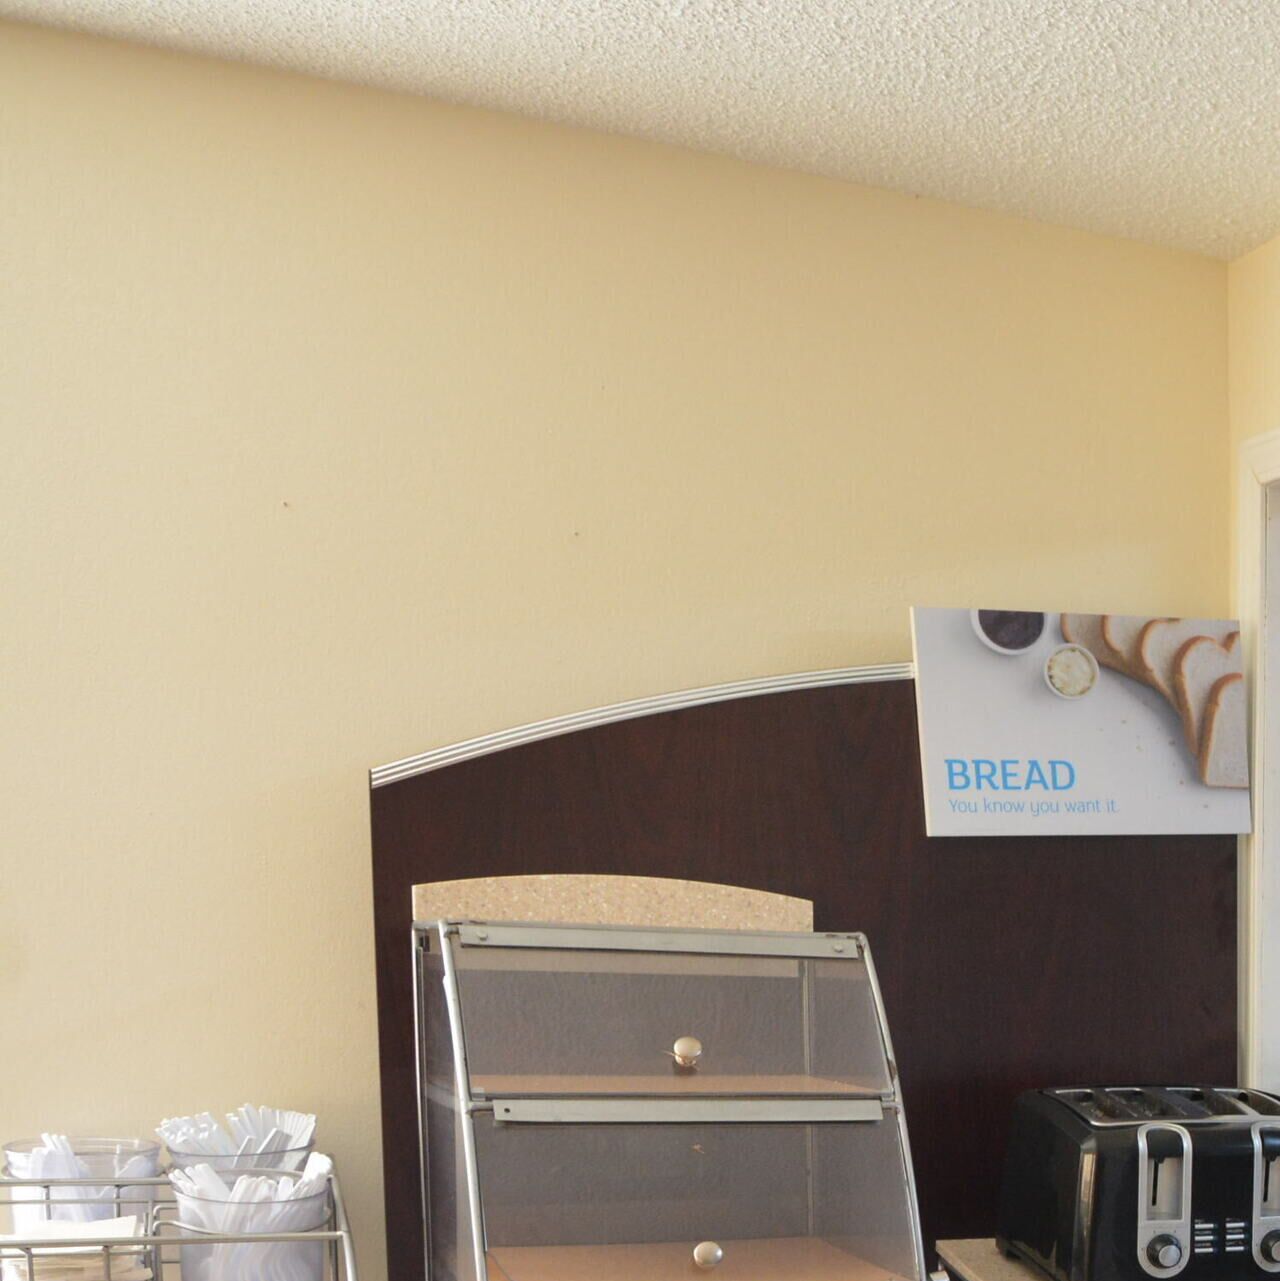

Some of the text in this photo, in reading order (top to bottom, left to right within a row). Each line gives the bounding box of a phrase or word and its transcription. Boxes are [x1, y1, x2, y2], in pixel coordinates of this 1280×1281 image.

[944, 759, 1076, 791] BREAD
[949, 799, 977, 813] You
[984, 798, 1025, 813] know
[1030, 800, 1059, 816] you
[1064, 799, 1101, 813] want
